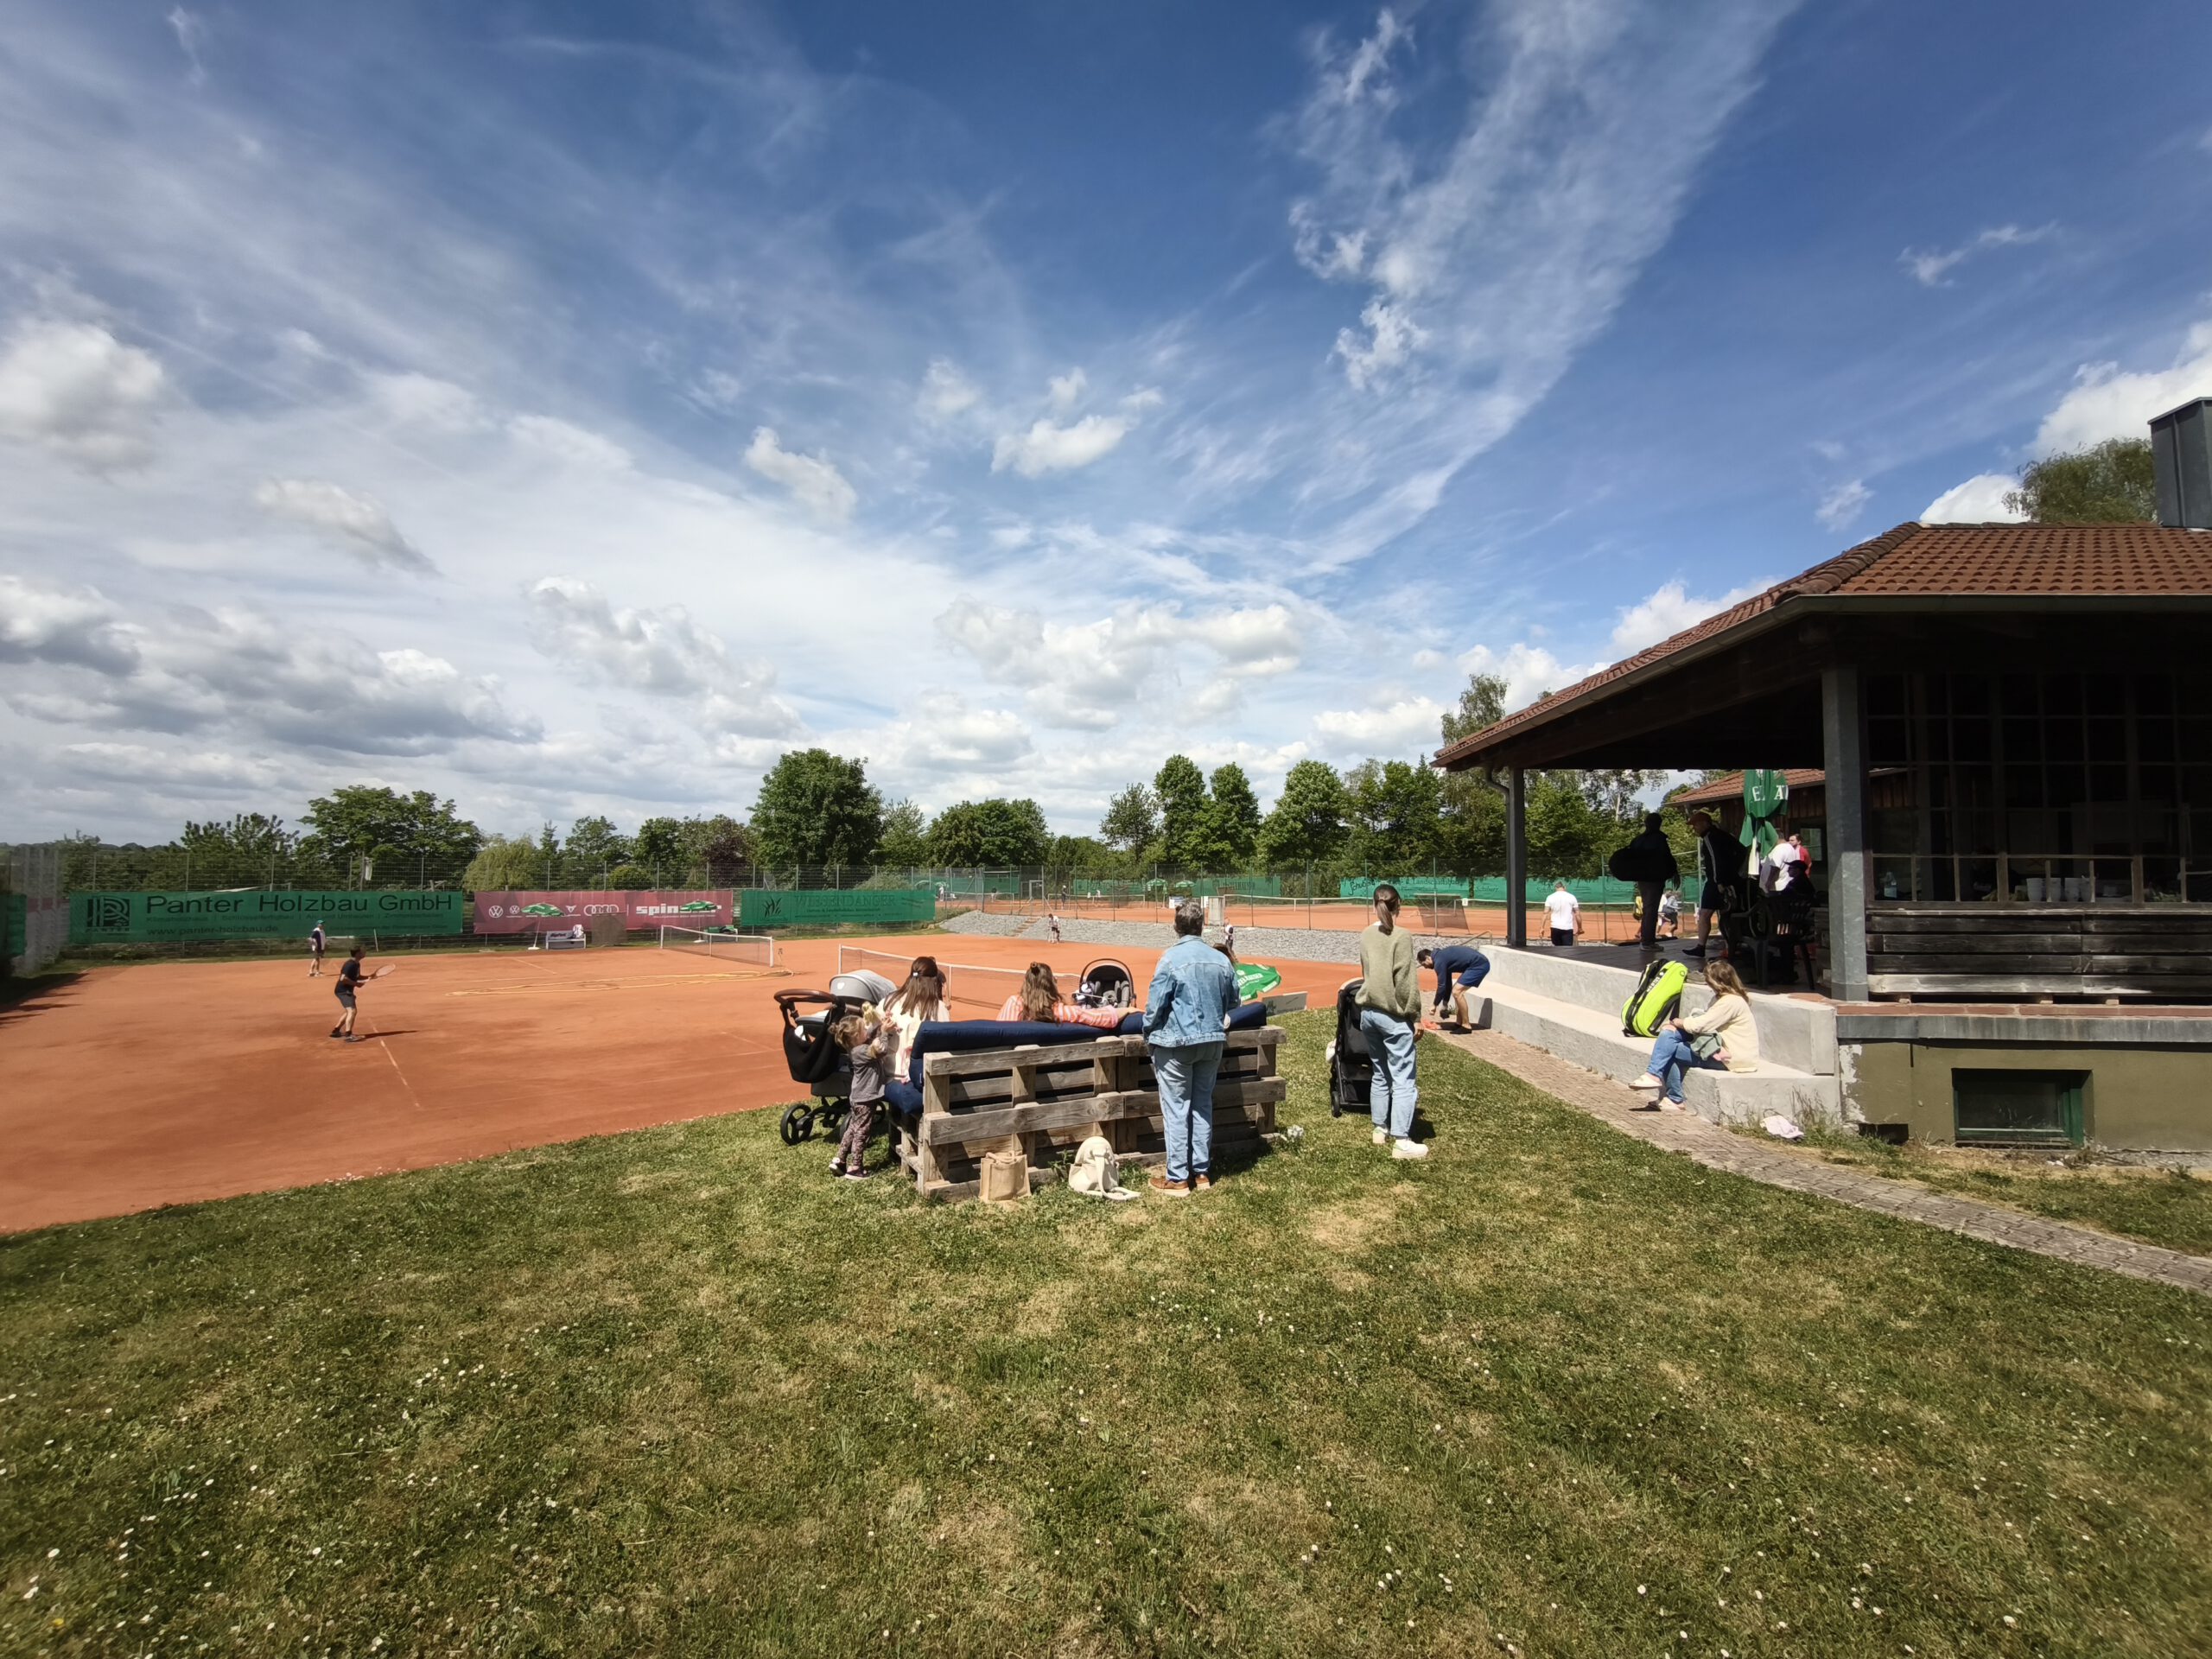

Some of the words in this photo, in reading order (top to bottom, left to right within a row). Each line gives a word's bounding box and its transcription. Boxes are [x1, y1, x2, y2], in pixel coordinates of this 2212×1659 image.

[146, 895, 244, 913] Panter
[258, 894, 367, 912] Holzbau
[378, 894, 452, 912] GmbH
[794, 894, 896, 907] WIESENDANGER
[146, 926, 278, 936] www.panter-holzbau.de
